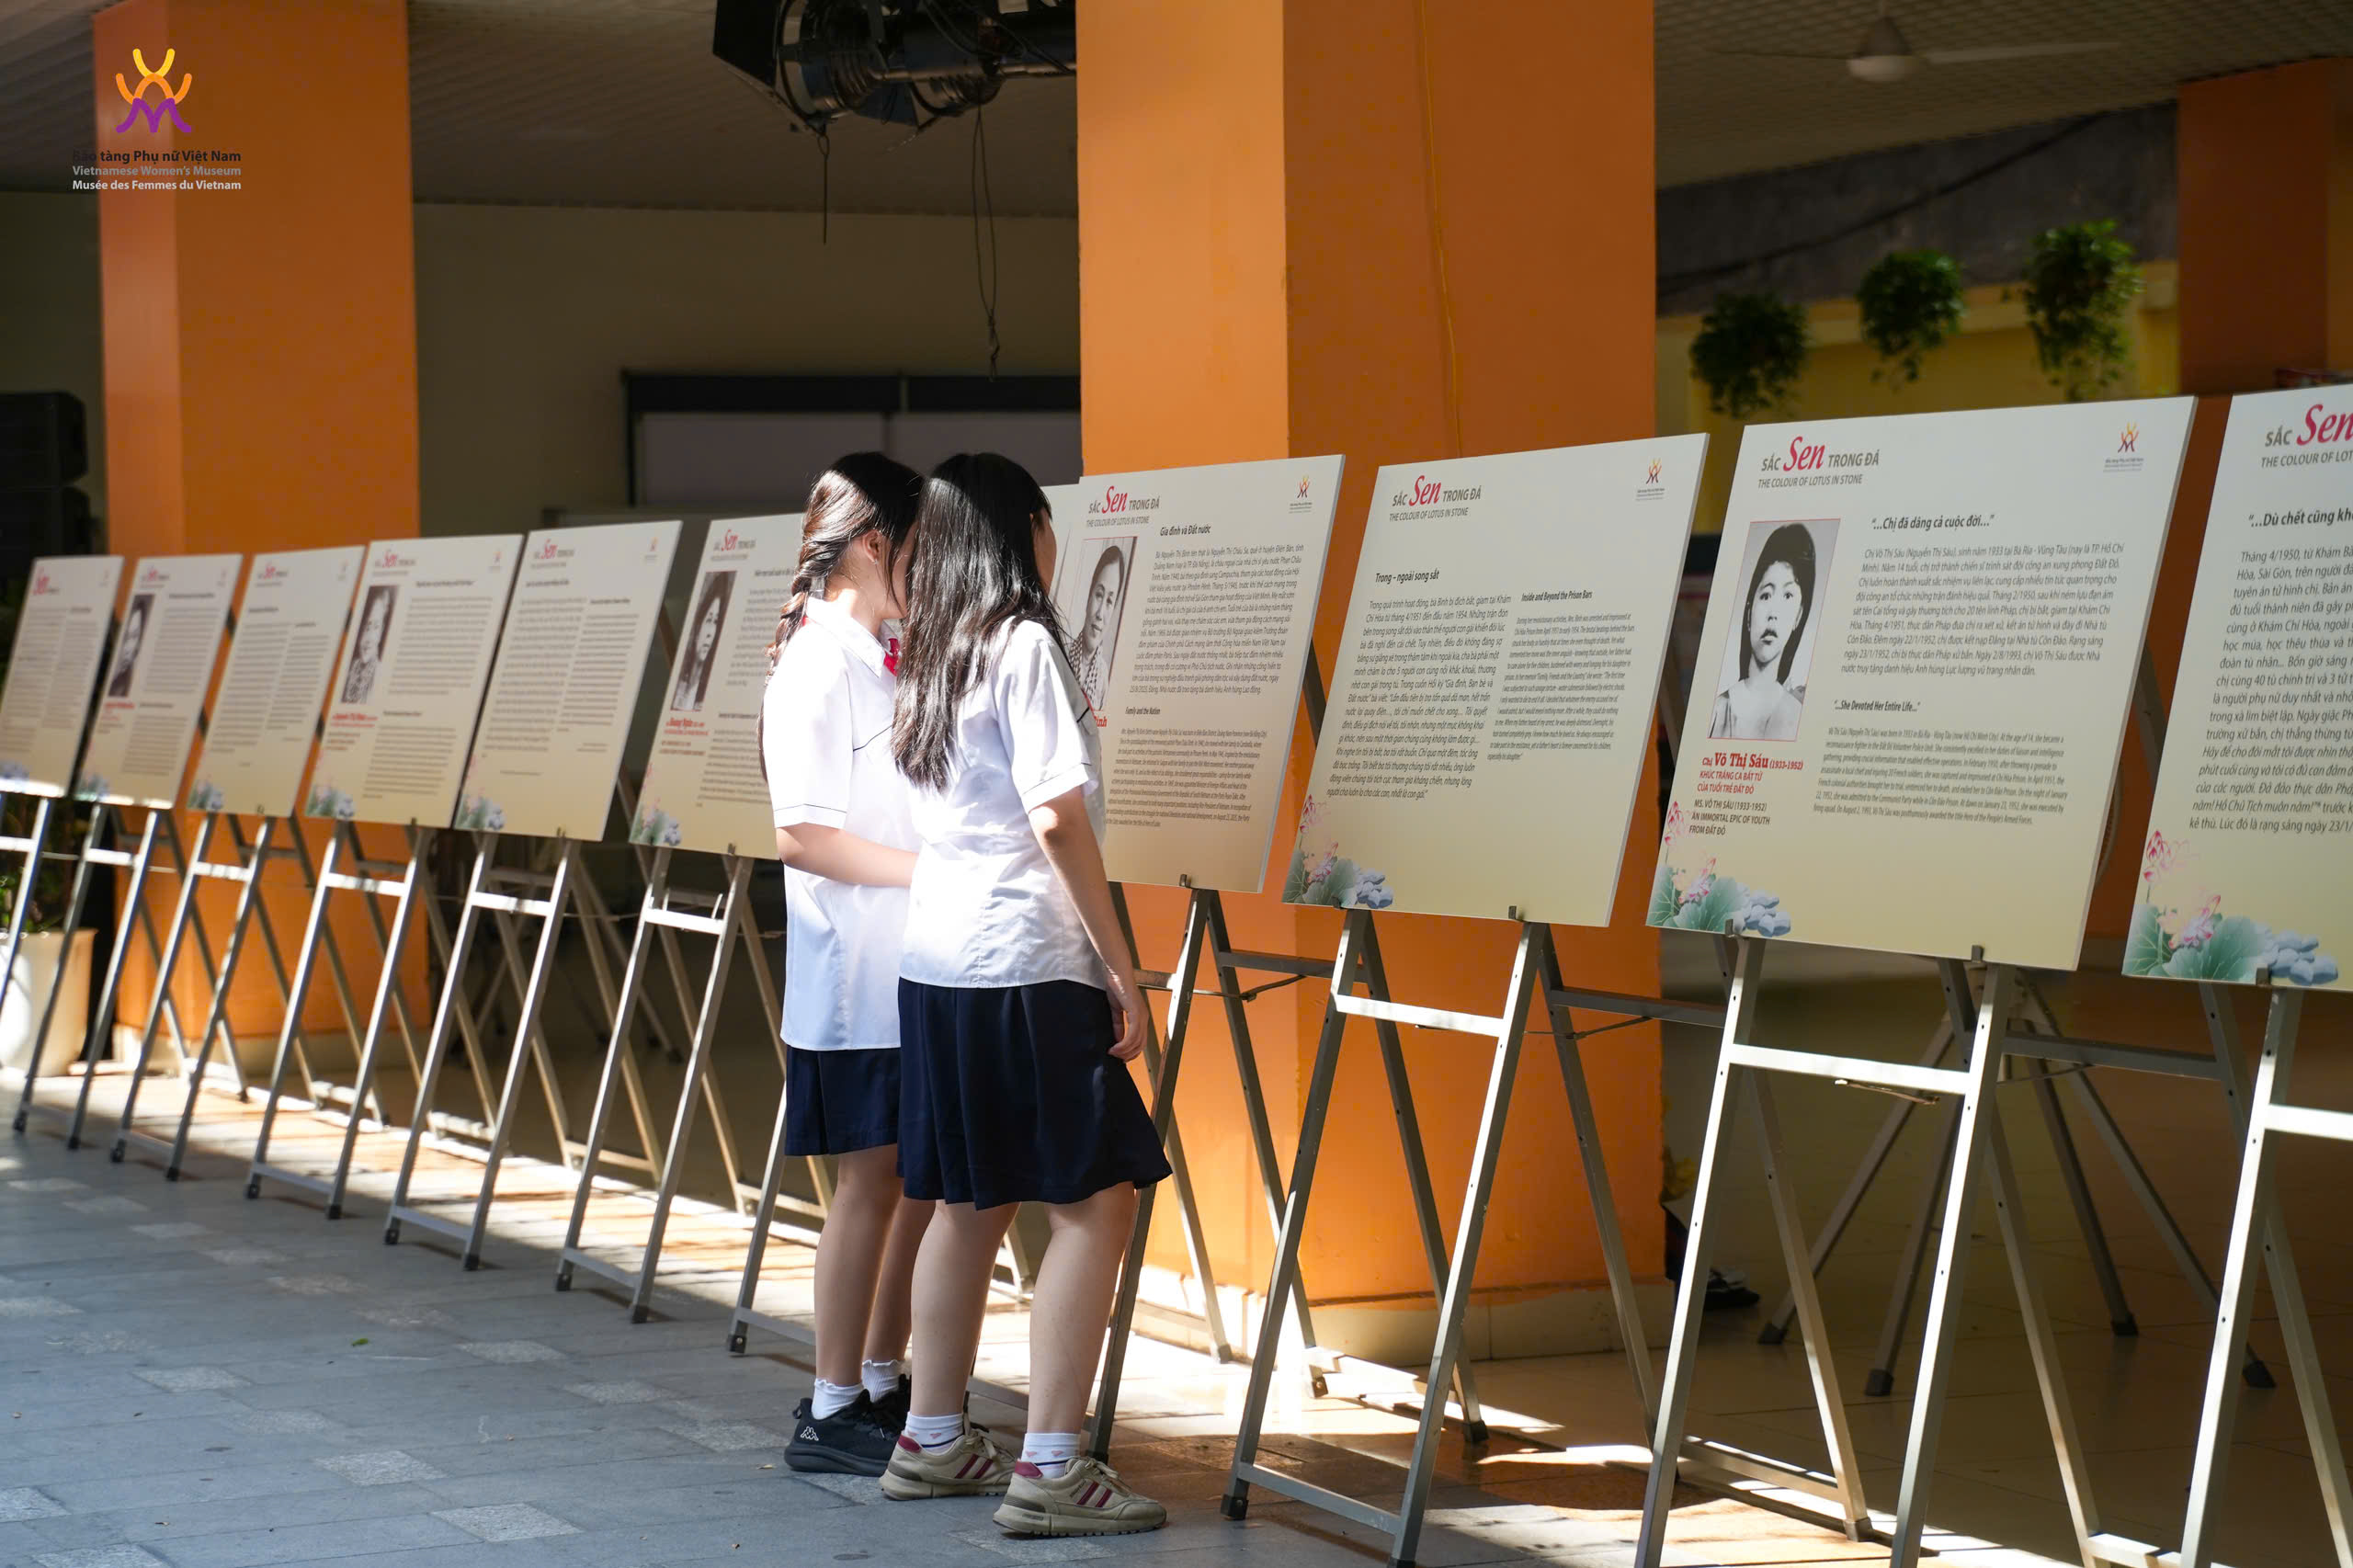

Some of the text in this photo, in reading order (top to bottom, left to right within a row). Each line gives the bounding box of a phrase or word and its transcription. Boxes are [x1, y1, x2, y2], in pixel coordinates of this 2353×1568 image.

[2296, 404, 2353, 446] Sen
[1783, 436, 1826, 472] Sen
[1828, 453, 1863, 468] TRONG
[1864, 449, 1880, 467] ĐÁ
[2261, 457, 2278, 468] THE
[2280, 454, 2319, 466] COLOUR
[2321, 452, 2333, 463] OF
[1758, 474, 1863, 489] THE COLOUR OF LOTUS IN STONE
[1409, 475, 1441, 506] Sen
[1443, 489, 1469, 502] TRONG
[1470, 485, 1482, 500] ĐÁ
[1102, 486, 1127, 514] Sen
[1129, 499, 1150, 510] TRONG
[1150, 496, 1160, 509] ĐÁ
[1390, 507, 1468, 521] THE COLOUR OF LOTUS IN STONE
[2281, 509, 2304, 525] chết
[2308, 509, 2335, 526] cũng
[1094, 518, 1111, 527] COLOUR
[1117, 517, 1130, 526] LOTUS
[1136, 516, 1149, 524] STONE
[1898, 515, 1909, 528] đã
[1910, 514, 1931, 531] dâng
[1934, 514, 1943, 528] cả
[1944, 517, 1964, 532] cuộc
[1160, 527, 1168, 536] Gia
[1169, 525, 1180, 535] đình
[1181, 525, 1187, 534] và
[1188, 524, 1197, 534] Đất
[2242, 551, 2267, 564] Tháng
[2269, 550, 2300, 561] 4/1950,
[2315, 546, 2341, 558] Khám
[1375, 572, 1392, 584] Trong
[1397, 571, 1413, 584] ngoài
[1414, 571, 1429, 583] song
[1430, 567, 1439, 580] sắt
[1521, 593, 1534, 601] Inside
[1535, 592, 1543, 601] and
[1544, 591, 1559, 602] Beyond
[1568, 590, 1582, 599] Prison
[1582, 590, 1592, 599] Bars
[2258, 621, 2283, 632] Khám
[2334, 638, 2343, 648] và
[2254, 675, 2265, 686] 40
[2317, 674, 2327, 684] và
[2329, 673, 2335, 684] 3
[1851, 700, 1873, 711] Devoted
[1874, 701, 1884, 711] Her
[1885, 701, 1901, 712] Entire
[1714, 753, 1727, 766] Võ
[1729, 753, 1747, 770] Thị
[1749, 753, 1769, 768] Sáu
[1769, 760, 1803, 770] (1933-1952)
[1735, 772, 1742, 780] CA
[1694, 799, 1704, 808] MS.
[1734, 801, 1767, 812] (1933-1952)
[1692, 812, 1770, 825] AN IMMORTAL EPIC OF YOUTH
[1689, 825, 1705, 834] FROM
